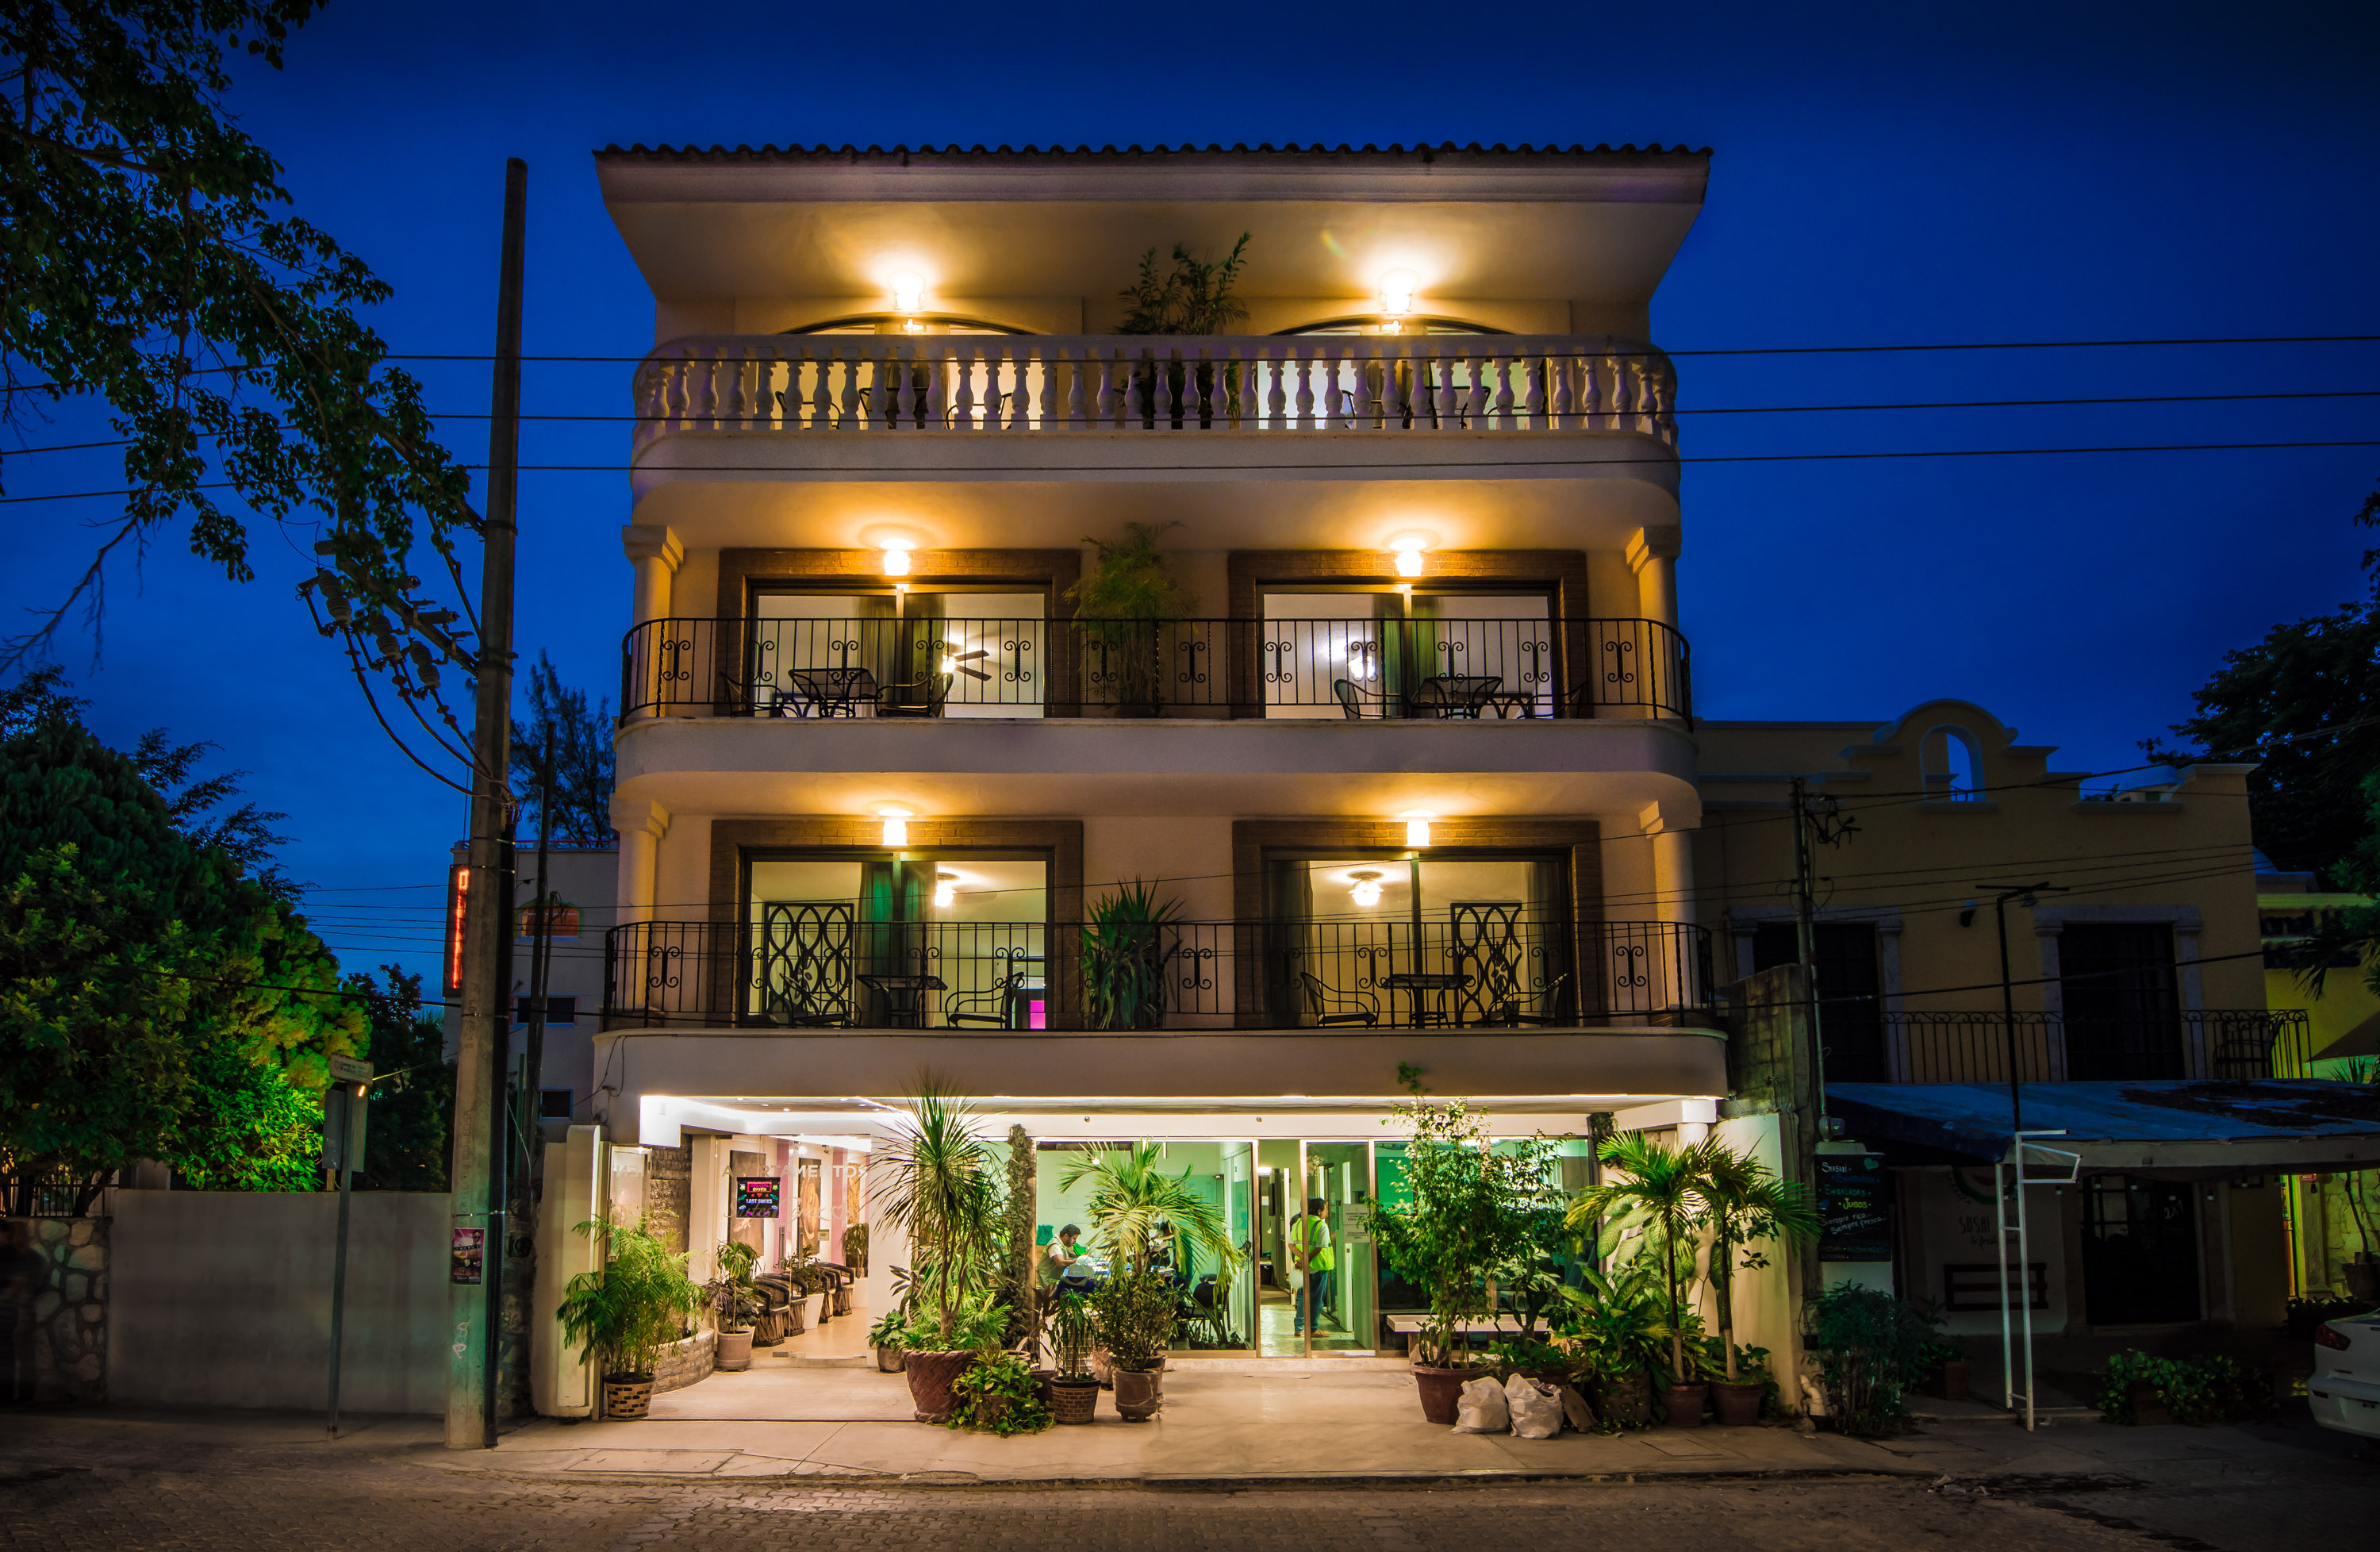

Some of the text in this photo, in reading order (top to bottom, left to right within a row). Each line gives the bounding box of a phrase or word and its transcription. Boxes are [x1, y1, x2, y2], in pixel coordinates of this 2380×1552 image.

[721, 1164, 868, 1178] ARTAMETOS
[1830, 1216, 1883, 1235] Siempre fresco
[1960, 1216, 1990, 1233] SUSHI
